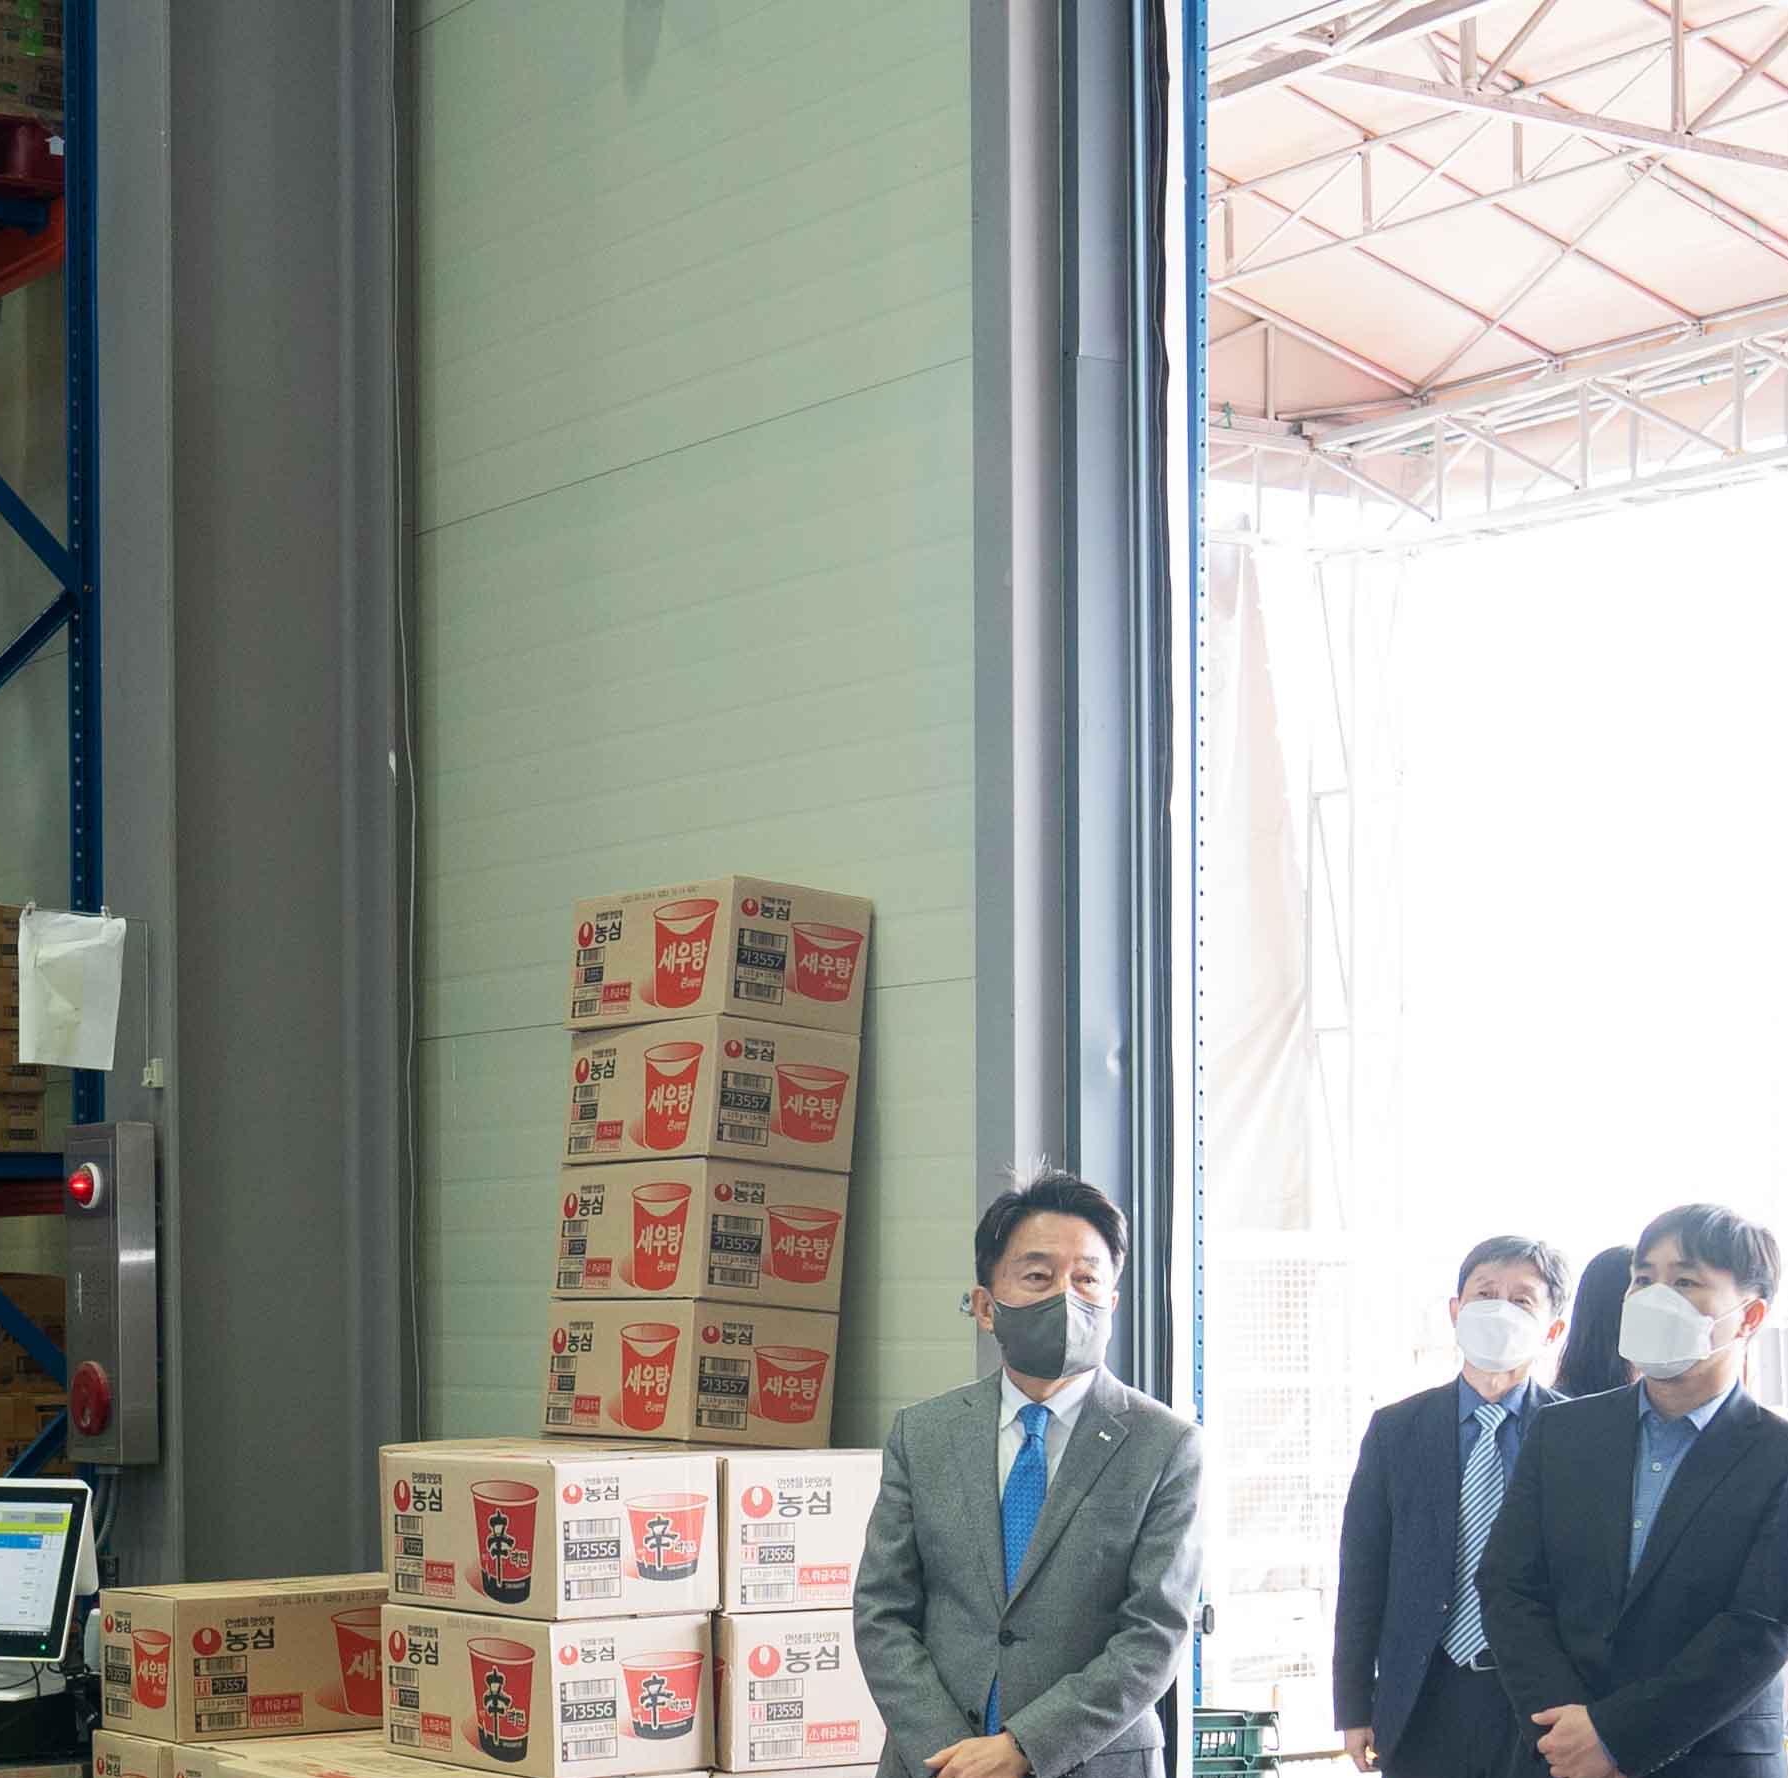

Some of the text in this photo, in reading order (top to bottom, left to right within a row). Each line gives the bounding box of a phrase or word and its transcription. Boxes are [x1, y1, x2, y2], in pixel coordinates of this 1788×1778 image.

[762, 904, 789, 921] 농심
[595, 921, 621, 943] 농심
[658, 939, 707, 974] 새우탕
[799, 952, 852, 978] 새우탕
[744, 1046, 774, 1062] 농심
[590, 1060, 615, 1081] 농심
[648, 1084, 693, 1116] 새우탕
[783, 1093, 838, 1119] 새우탕
[579, 1195, 603, 1217] 농심
[734, 1187, 765, 1204] 농심
[636, 1224, 682, 1256] 새우탕
[774, 1234, 831, 1260] 새우탕
[568, 1331, 593, 1352] 농심
[722, 1329, 753, 1345] 농심
[625, 1364, 670, 1397] 새우탕
[763, 1375, 819, 1400] 새우탕
[413, 1486, 442, 1512] 농심
[585, 1485, 619, 1502] 농심
[778, 1491, 831, 1518] 농심
[488, 1508, 514, 1587] 辛
[568, 1542, 617, 1557] 가3556
[644, 1515, 680, 1569] 辛
[761, 1547, 793, 1561] 가3556
[226, 1628, 275, 1652] 농심
[409, 1639, 438, 1665] 농심
[581, 1646, 614, 1663] 농심
[786, 1645, 839, 1673] 농심
[137, 1659, 166, 1686] 새우탕
[484, 1666, 511, 1744] 辛
[564, 1703, 612, 1720] 가3556
[639, 1673, 675, 1729] 辛
[769, 1703, 801, 1719] 가3556
